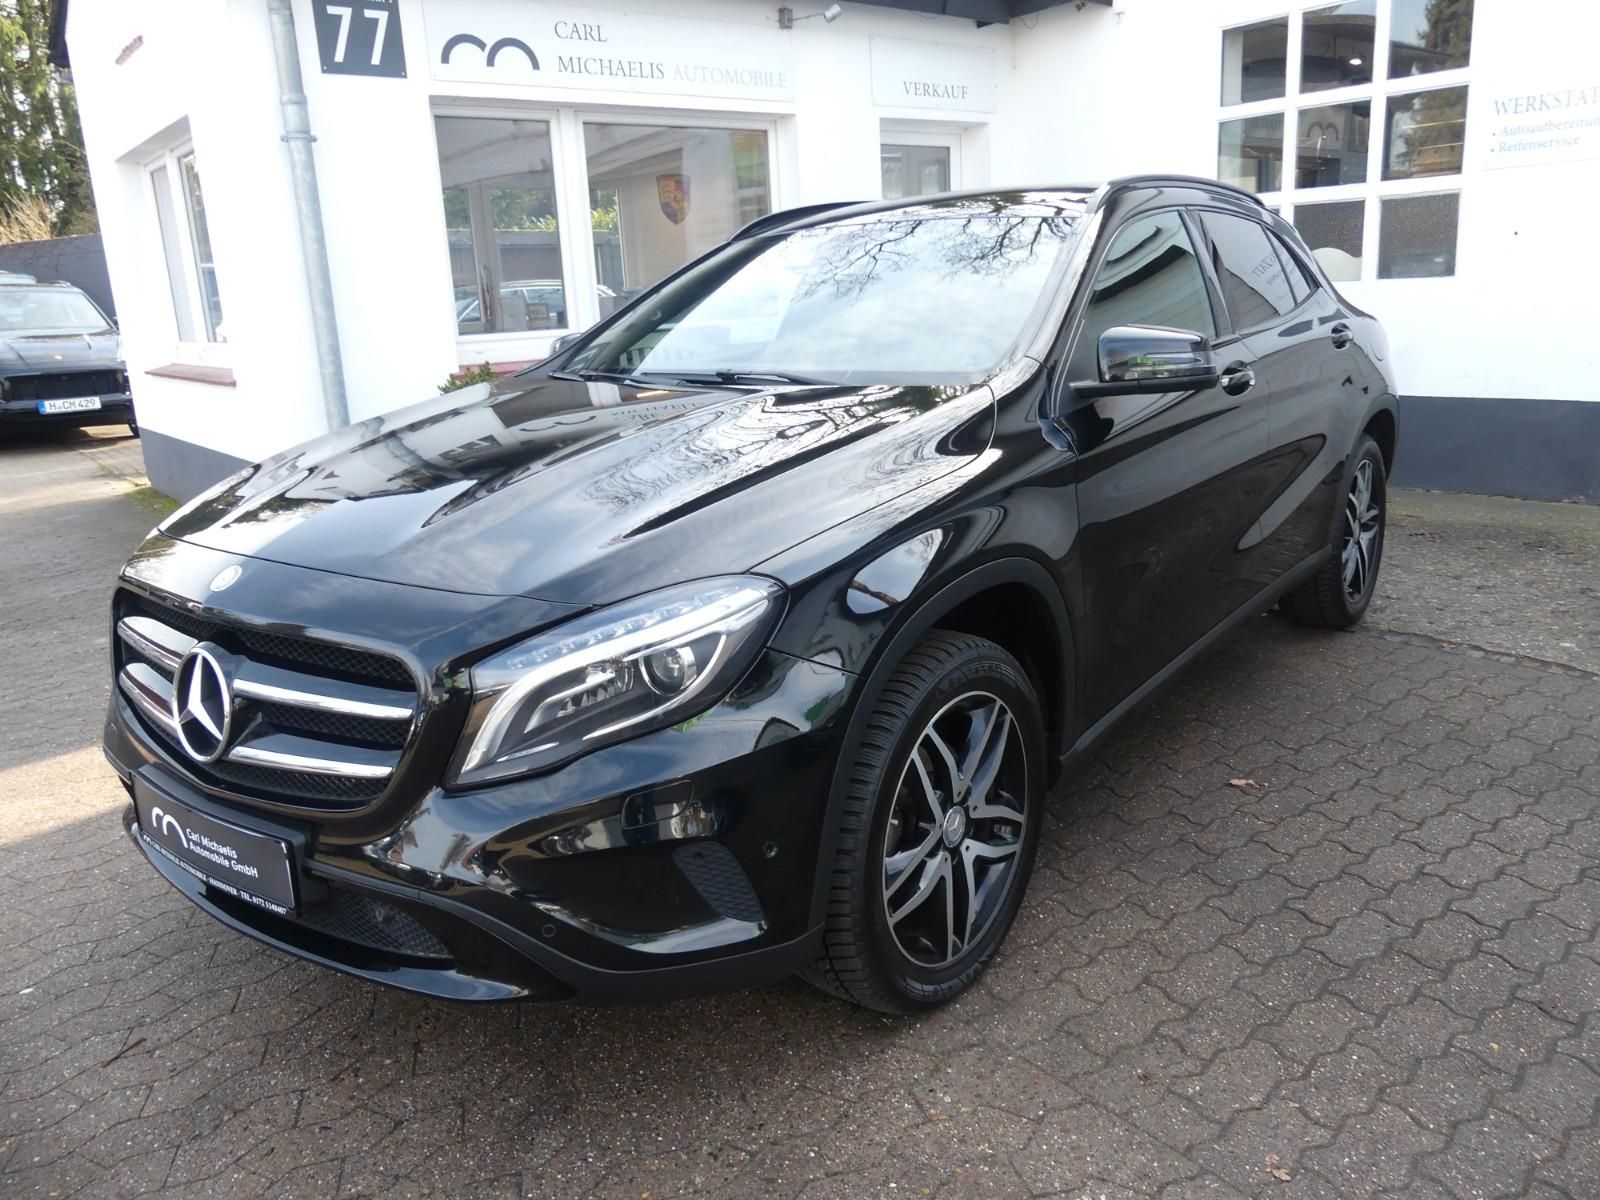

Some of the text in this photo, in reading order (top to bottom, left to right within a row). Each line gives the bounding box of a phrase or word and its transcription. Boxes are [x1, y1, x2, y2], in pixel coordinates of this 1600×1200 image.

[325, 4, 390, 66] 77
[553, 20, 608, 43] CARL
[557, 55, 788, 89] MICHAELIS AUTOMOBILE
[902, 80, 969, 100] VERKAUF
[1498, 136, 1581, 154] Reifenservice
[186, 827, 201, 843] Carl
[200, 835, 238, 859] Michaelis
[189, 841, 230, 868] Automobile
[231, 860, 259, 879] GmbH
